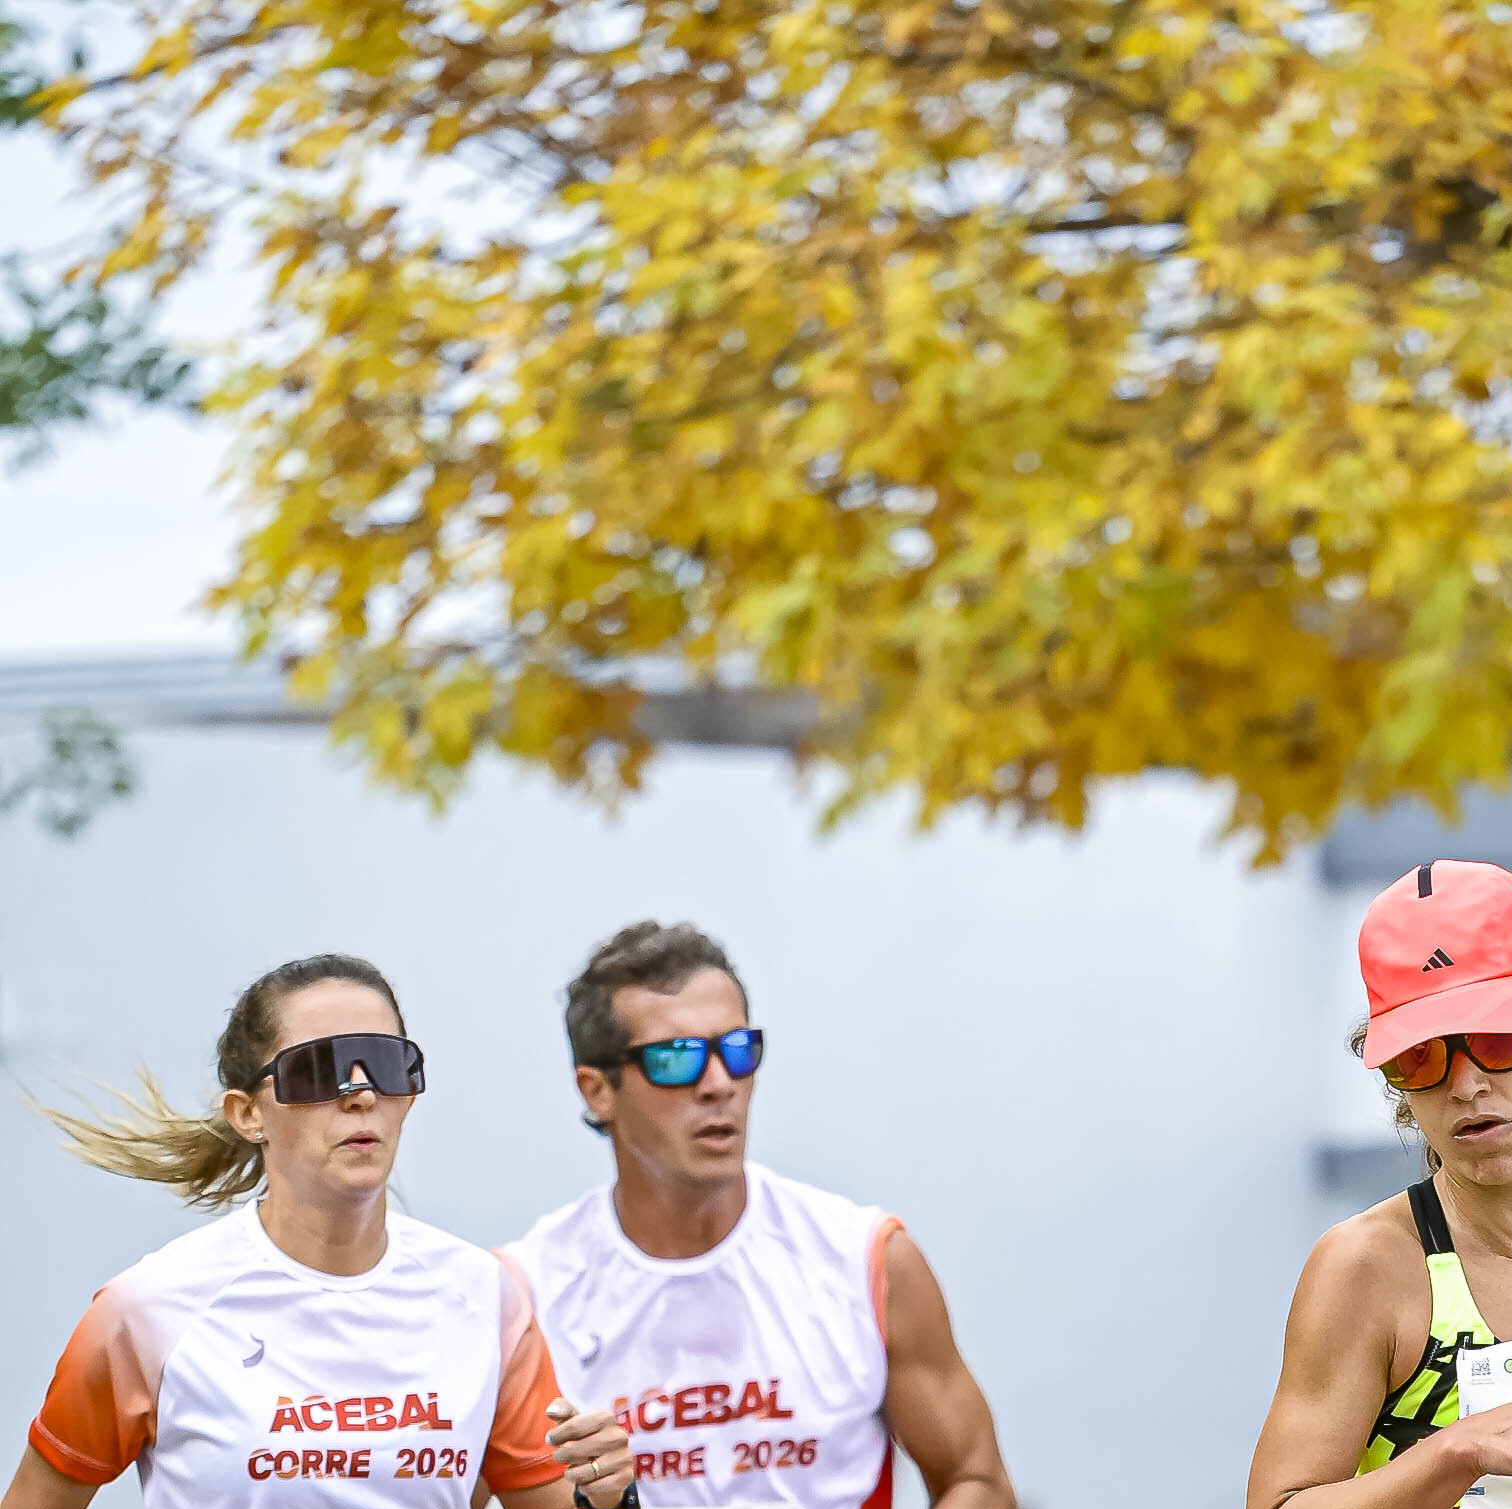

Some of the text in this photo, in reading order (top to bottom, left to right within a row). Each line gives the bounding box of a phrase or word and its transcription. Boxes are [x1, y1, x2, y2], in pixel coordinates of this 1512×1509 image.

[269, 1393, 453, 1433] ACEBAL
[612, 1379, 793, 1434] ACEBAL
[248, 1448, 468, 1481] CORRE 2026
[635, 1439, 817, 1481] RRE 2026
